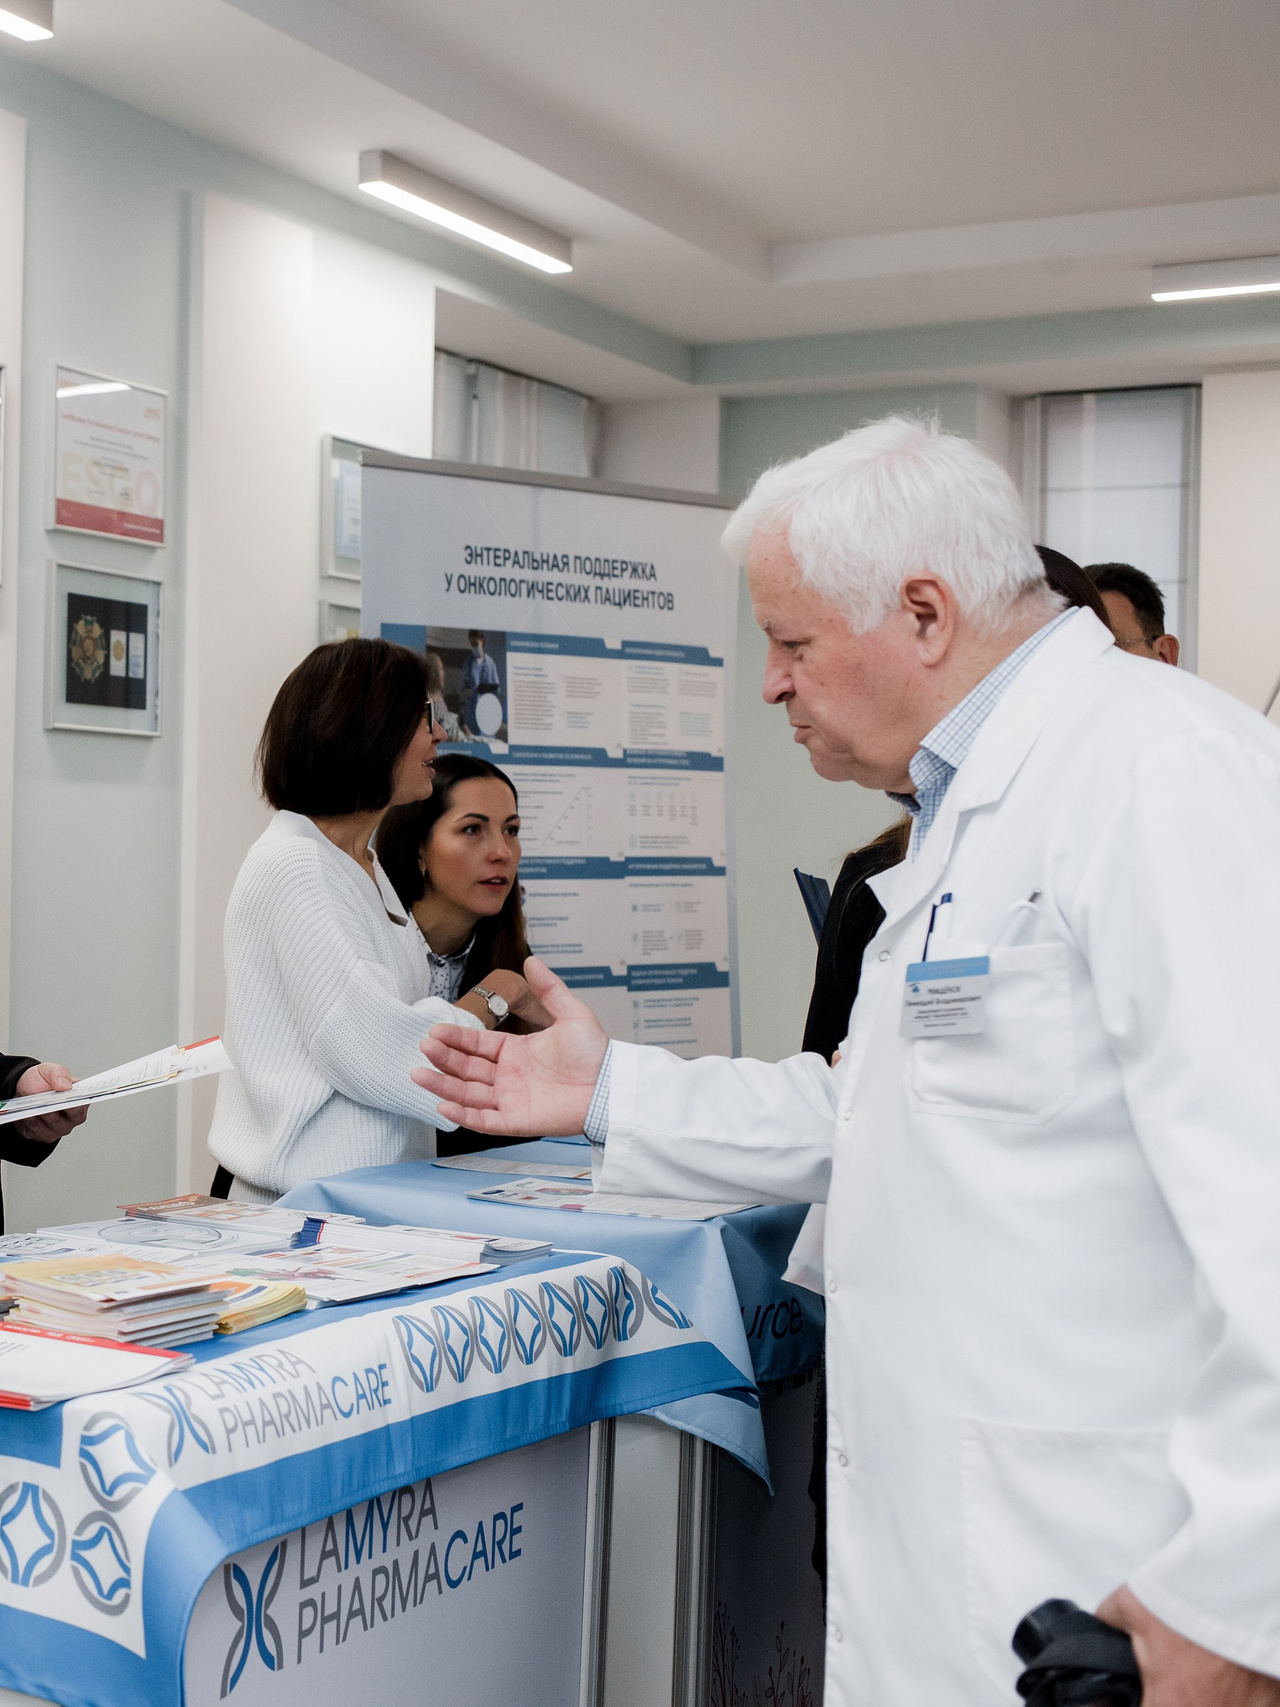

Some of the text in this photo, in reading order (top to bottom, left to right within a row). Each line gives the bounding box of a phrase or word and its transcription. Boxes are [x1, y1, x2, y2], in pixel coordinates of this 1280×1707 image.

[444, 573, 675, 611] У ОНКОЛОГИЧЕСКИХ ПАЦИЕНТОВ
[464, 545, 658, 582] ЭНТЕРАЛЬНАЯ ПОДДЕРЖКА
[179, 1349, 316, 1400] LAMYRA
[218, 1363, 392, 1453] PHARMACARE
[300, 1478, 438, 1590] LAMYRA
[297, 1502, 524, 1665] PHARMACARE
